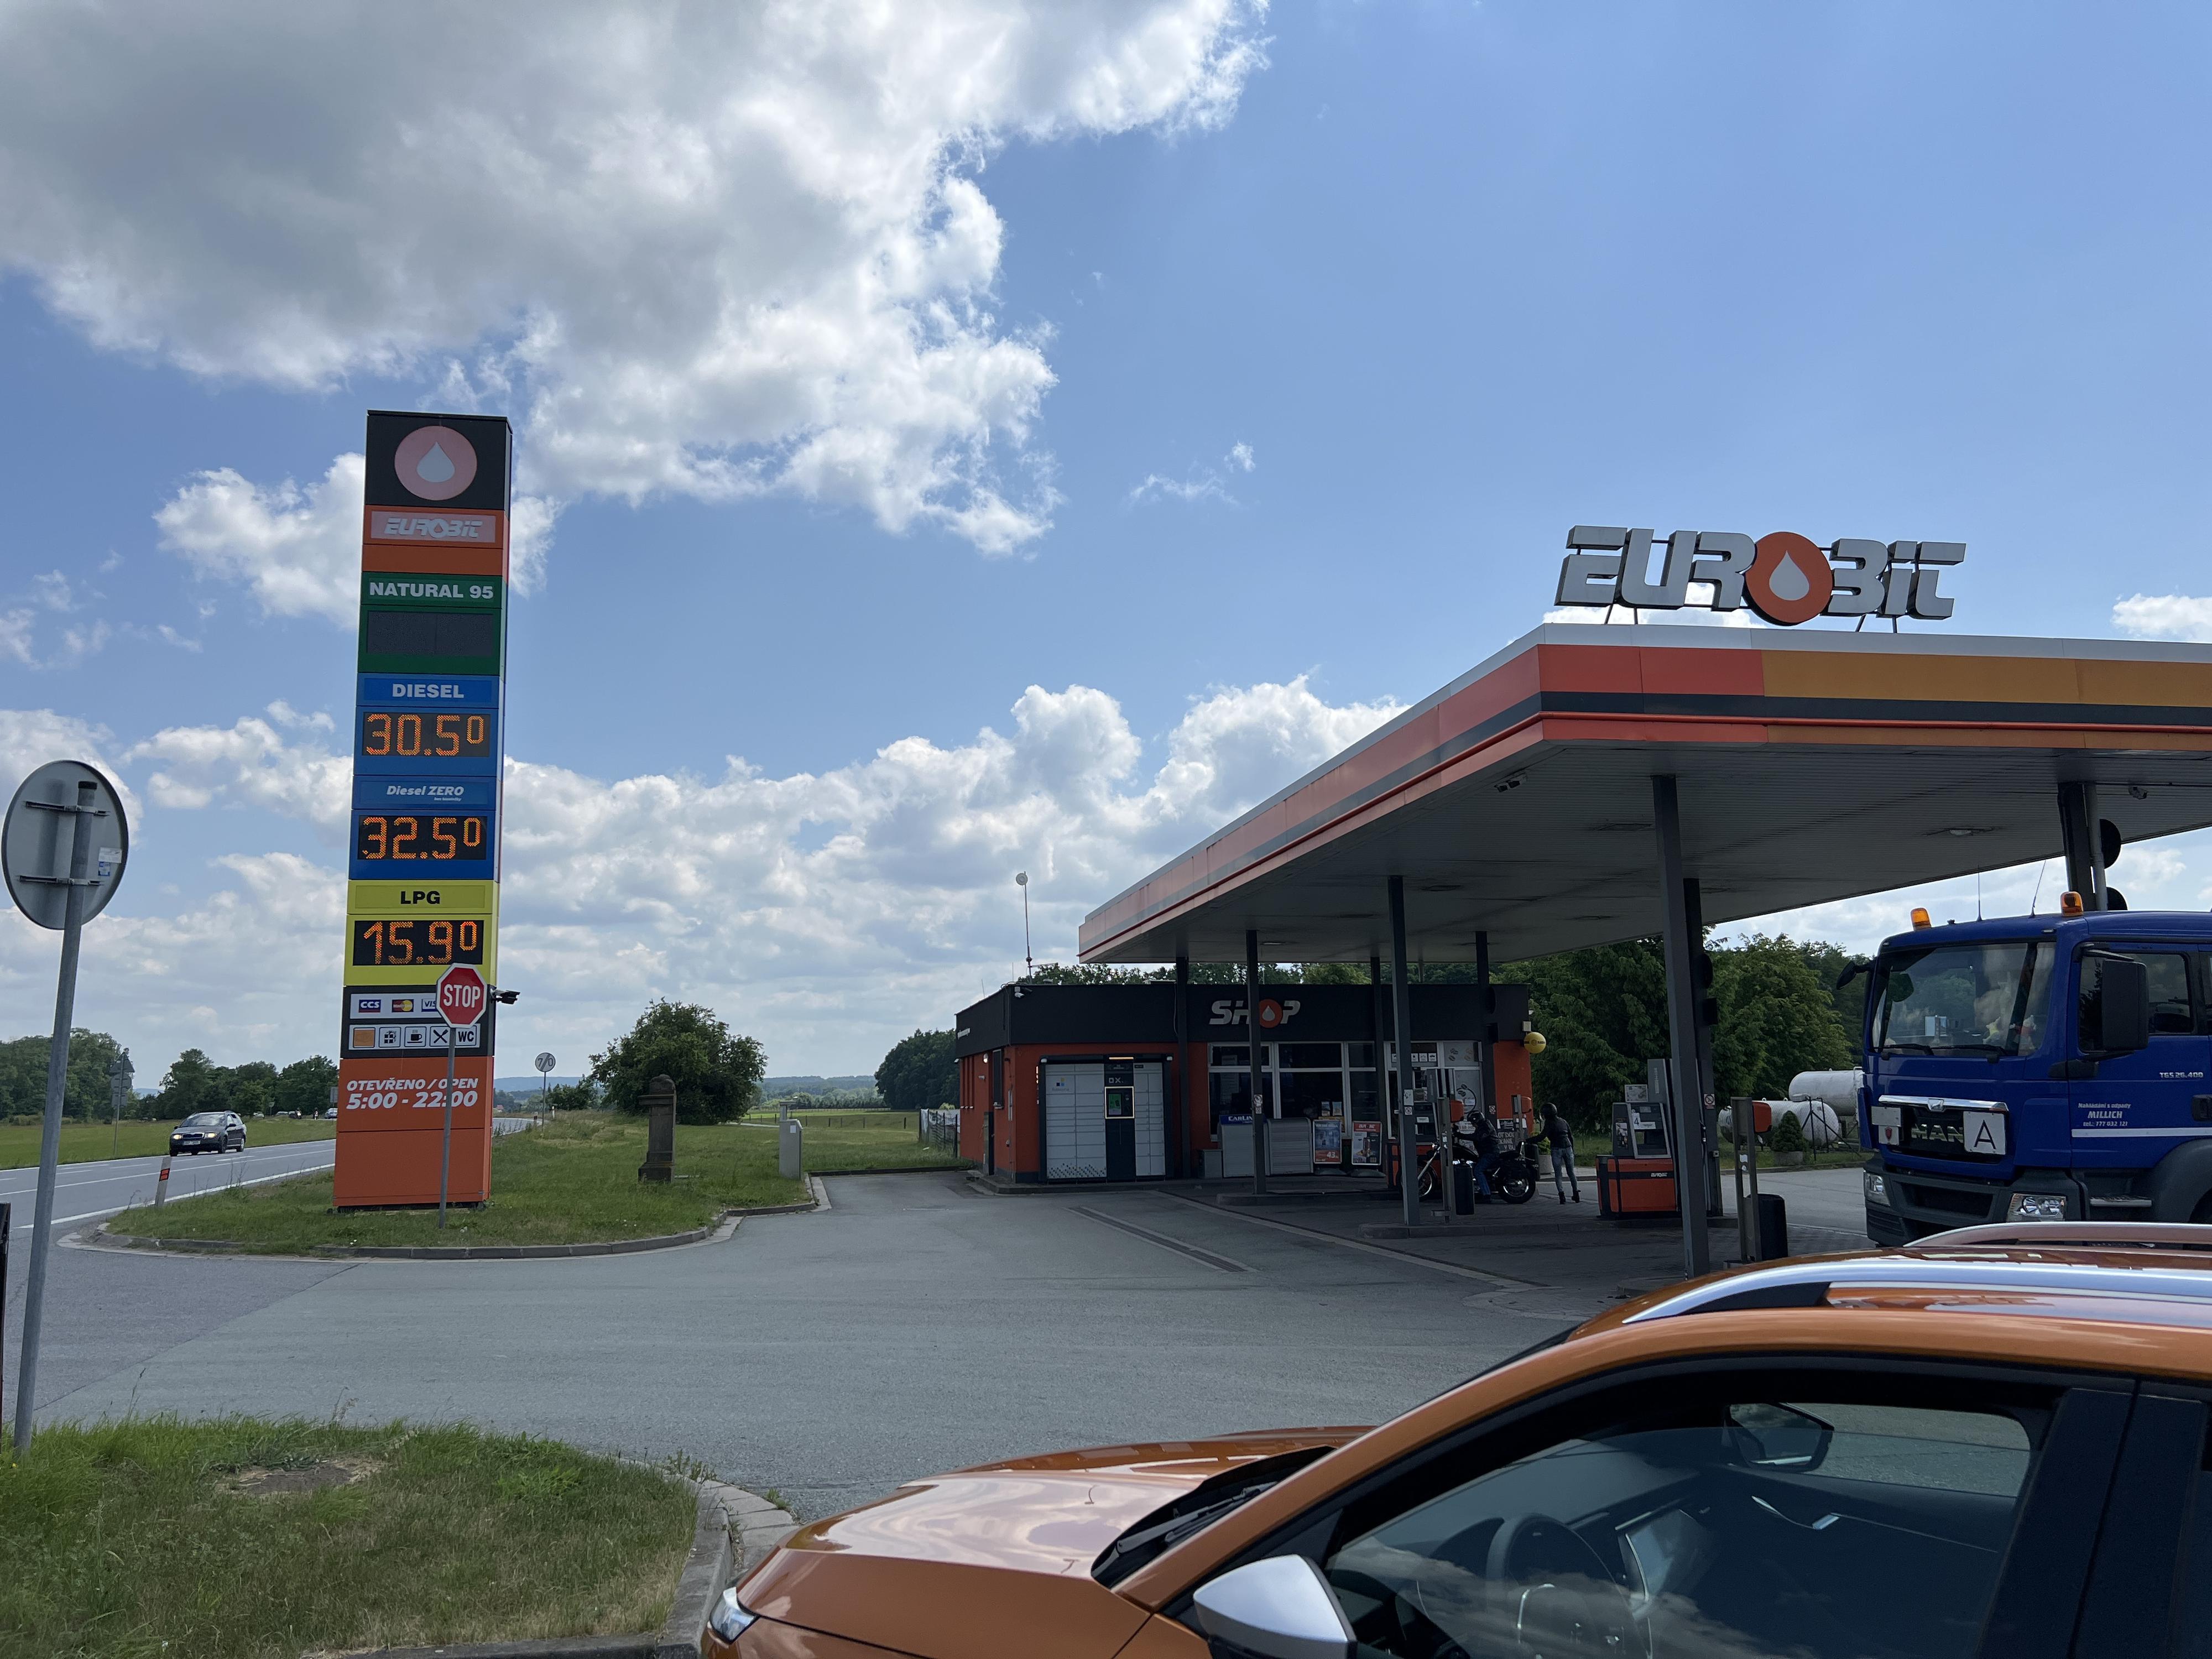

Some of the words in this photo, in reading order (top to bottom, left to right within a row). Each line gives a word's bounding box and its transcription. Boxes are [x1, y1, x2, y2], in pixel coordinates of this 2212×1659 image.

[369, 582, 463, 598] NATURAL
[469, 586, 493, 599] 95
[392, 684, 464, 698] DIESEL
[387, 785, 426, 795] Diesel
[427, 786, 465, 796] ZERO
[400, 891, 440, 904] LPG
[444, 984, 481, 1008] STOP
[458, 1031, 474, 1042] WC
[538, 1058, 553, 1067] 70
[347, 1078, 425, 1091] OTEVŘENO
[346, 1092, 398, 1109] 5:00
[413, 1091, 478, 1108] 22:00
[2088, 1110, 2123, 1119] MILLICH
[1634, 1118, 1639, 1126] 4
[1911, 1124, 1964, 1143] MAN
[1974, 1120, 1996, 1150] A
